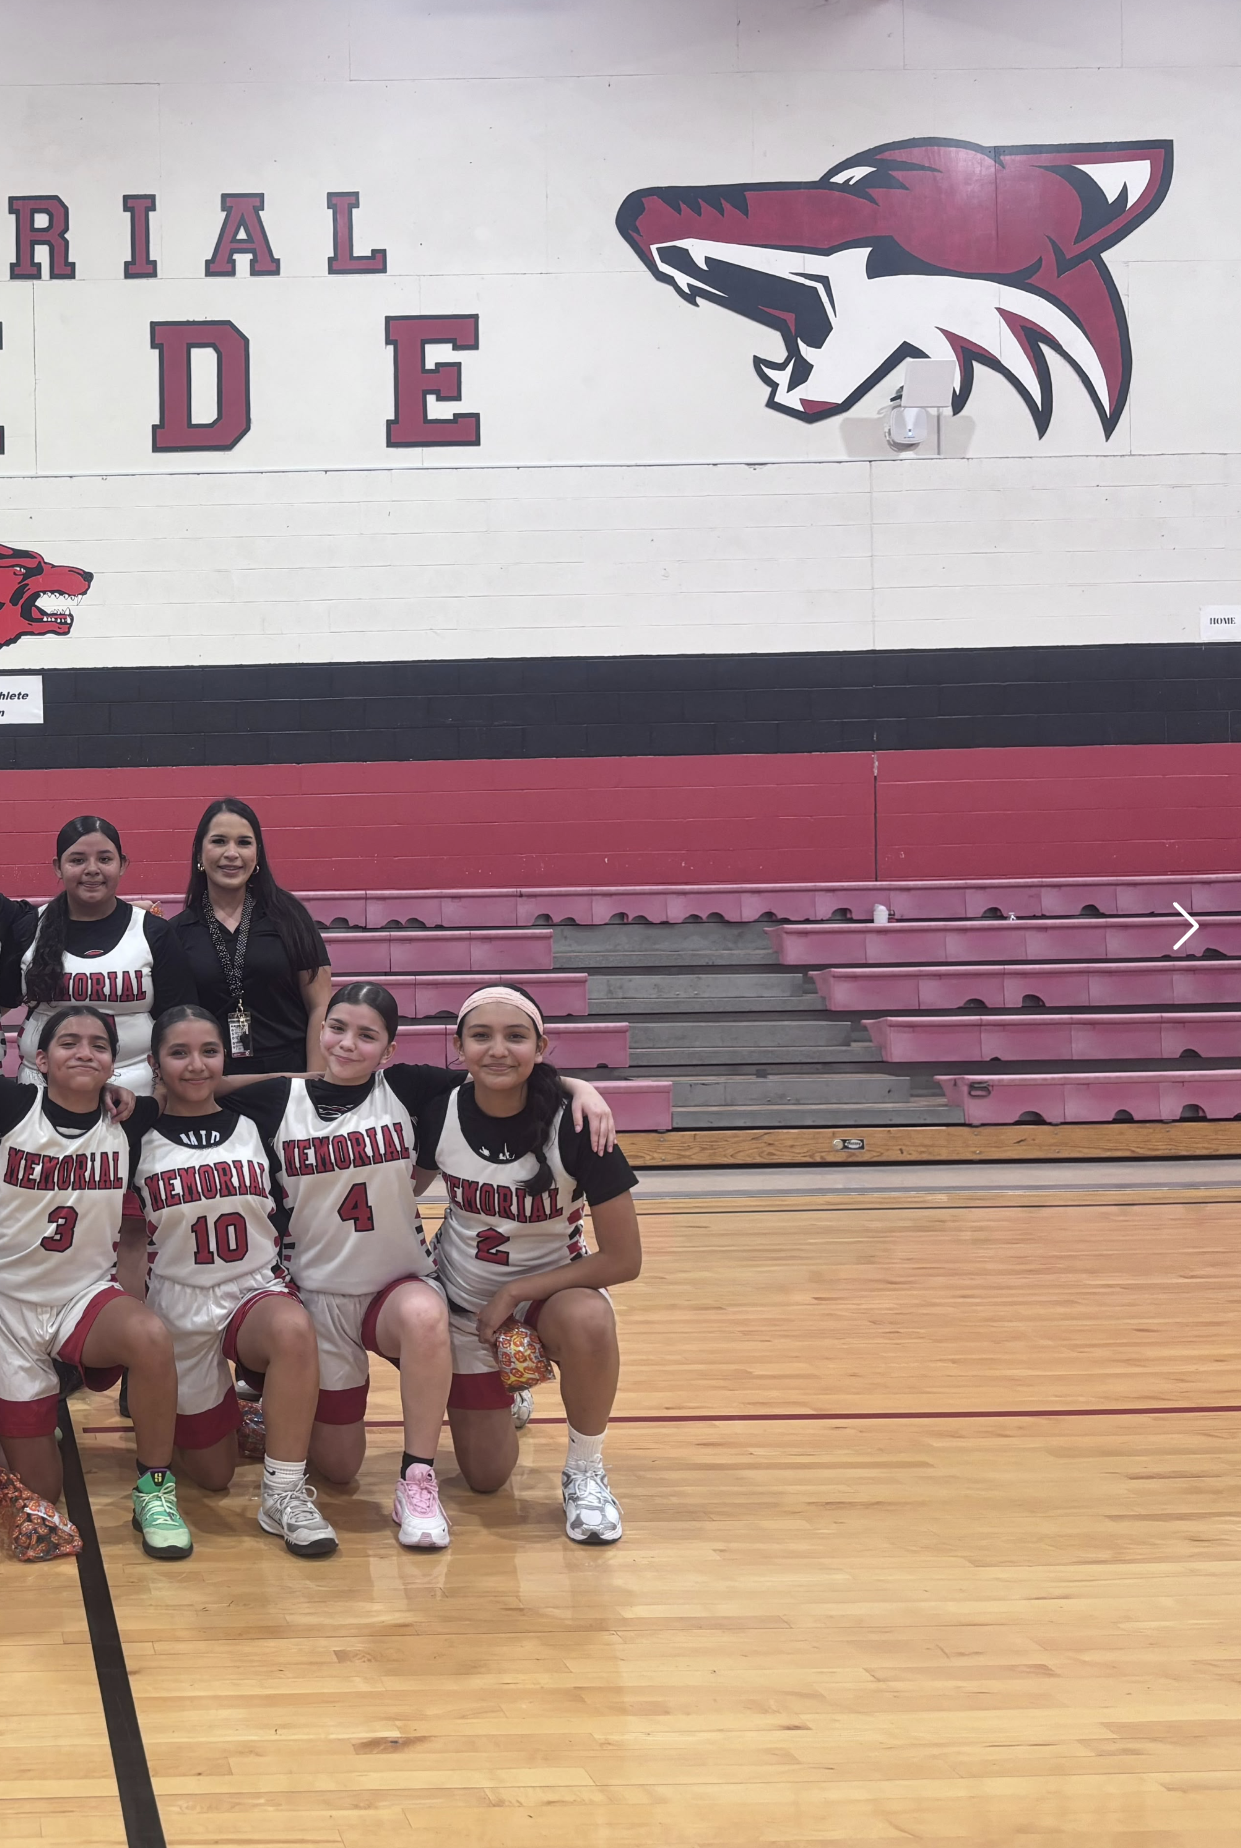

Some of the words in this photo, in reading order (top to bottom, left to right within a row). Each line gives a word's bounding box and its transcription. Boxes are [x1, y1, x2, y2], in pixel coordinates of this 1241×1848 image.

[1209, 617, 1236, 625] HOME
[63, 970, 147, 1003] ORIAL
[4, 1147, 123, 1191] MEMORIAL
[282, 1122, 410, 1177] MEMORIAL
[145, 1160, 269, 1212] MEMORIAL
[337, 1182, 375, 1233] 4
[40, 1205, 79, 1253] 3
[191, 1212, 248, 1265] 10
[475, 1227, 510, 1266] 2
